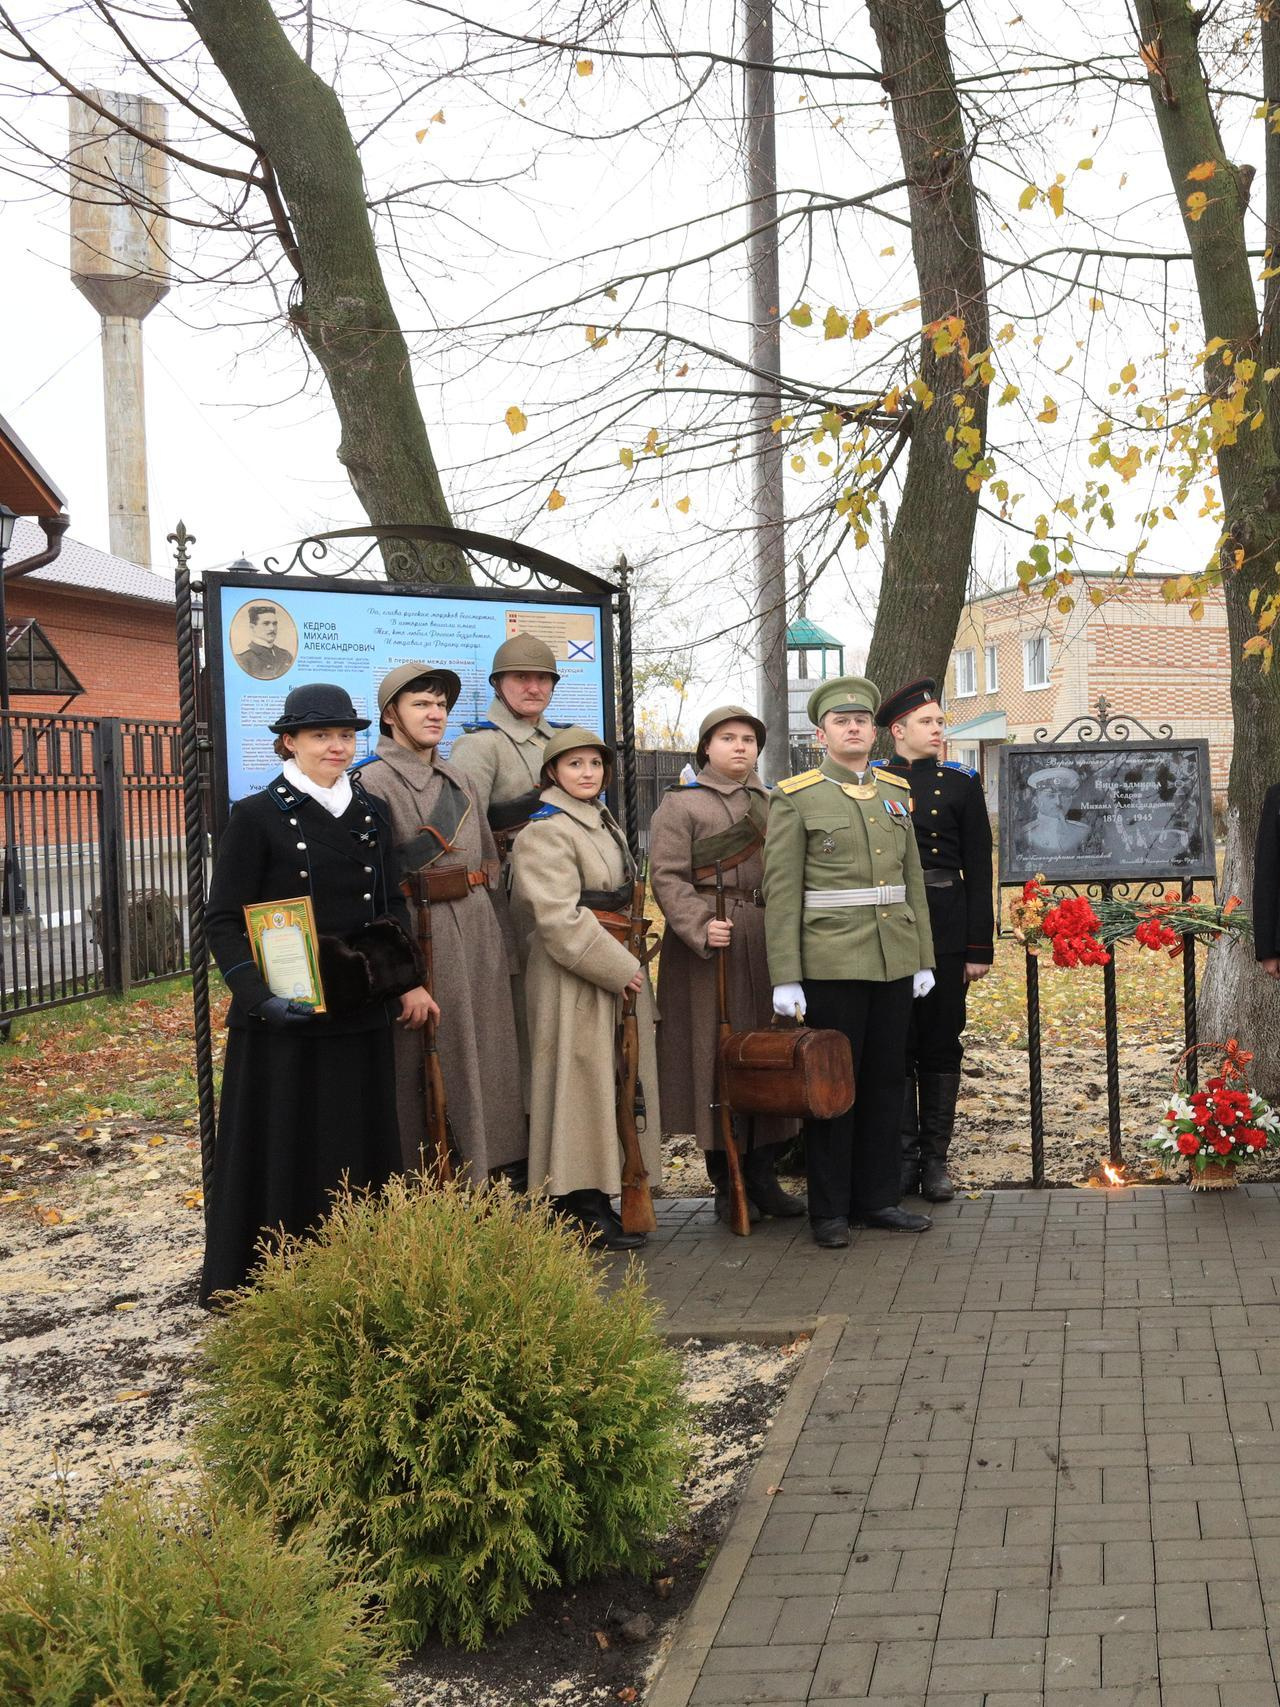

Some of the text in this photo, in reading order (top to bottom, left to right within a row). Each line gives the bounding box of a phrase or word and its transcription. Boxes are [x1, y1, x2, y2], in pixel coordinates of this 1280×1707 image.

[303, 622, 336, 631] КЕДРОВ
[303, 632, 339, 640] МИХАИЛ
[303, 642, 375, 652] АЛЕКСАНДРОВИЧ
[393, 657, 426, 665] перерыве
[427, 658, 447, 666] между
[1094, 780, 1162, 791] Вице-адмирал
[1113, 791, 1143, 800] Кедров
[1080, 801, 1176, 810] Михаил Александрович
[1103, 814, 1123, 823] 1878
[1133, 813, 1153, 822] 1945
